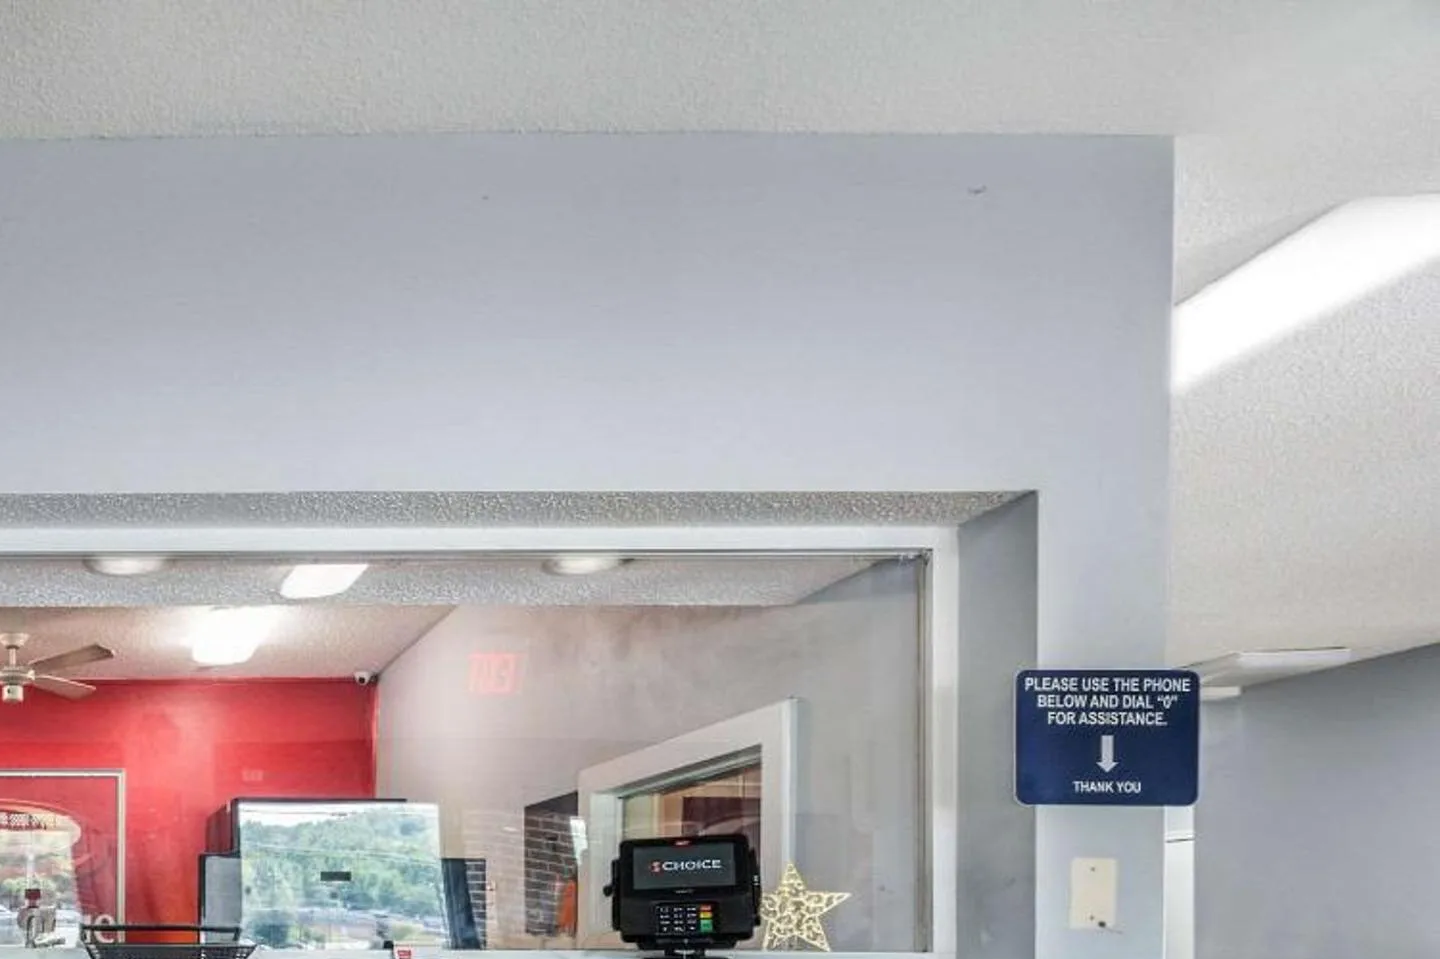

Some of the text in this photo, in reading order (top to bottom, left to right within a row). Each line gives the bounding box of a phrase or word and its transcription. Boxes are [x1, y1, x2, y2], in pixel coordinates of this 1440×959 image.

[1024, 677, 1191, 692] PLEASE USE THE PHONE
[1037, 694, 1087, 709] BELOW
[1090, 695, 1118, 709] AND
[1122, 695, 1154, 709] DIAL
[1047, 711, 1168, 726] FOR ASSISTANCE.
[1072, 780, 1142, 794] THANK YOU
[662, 859, 722, 871] CHOICE
